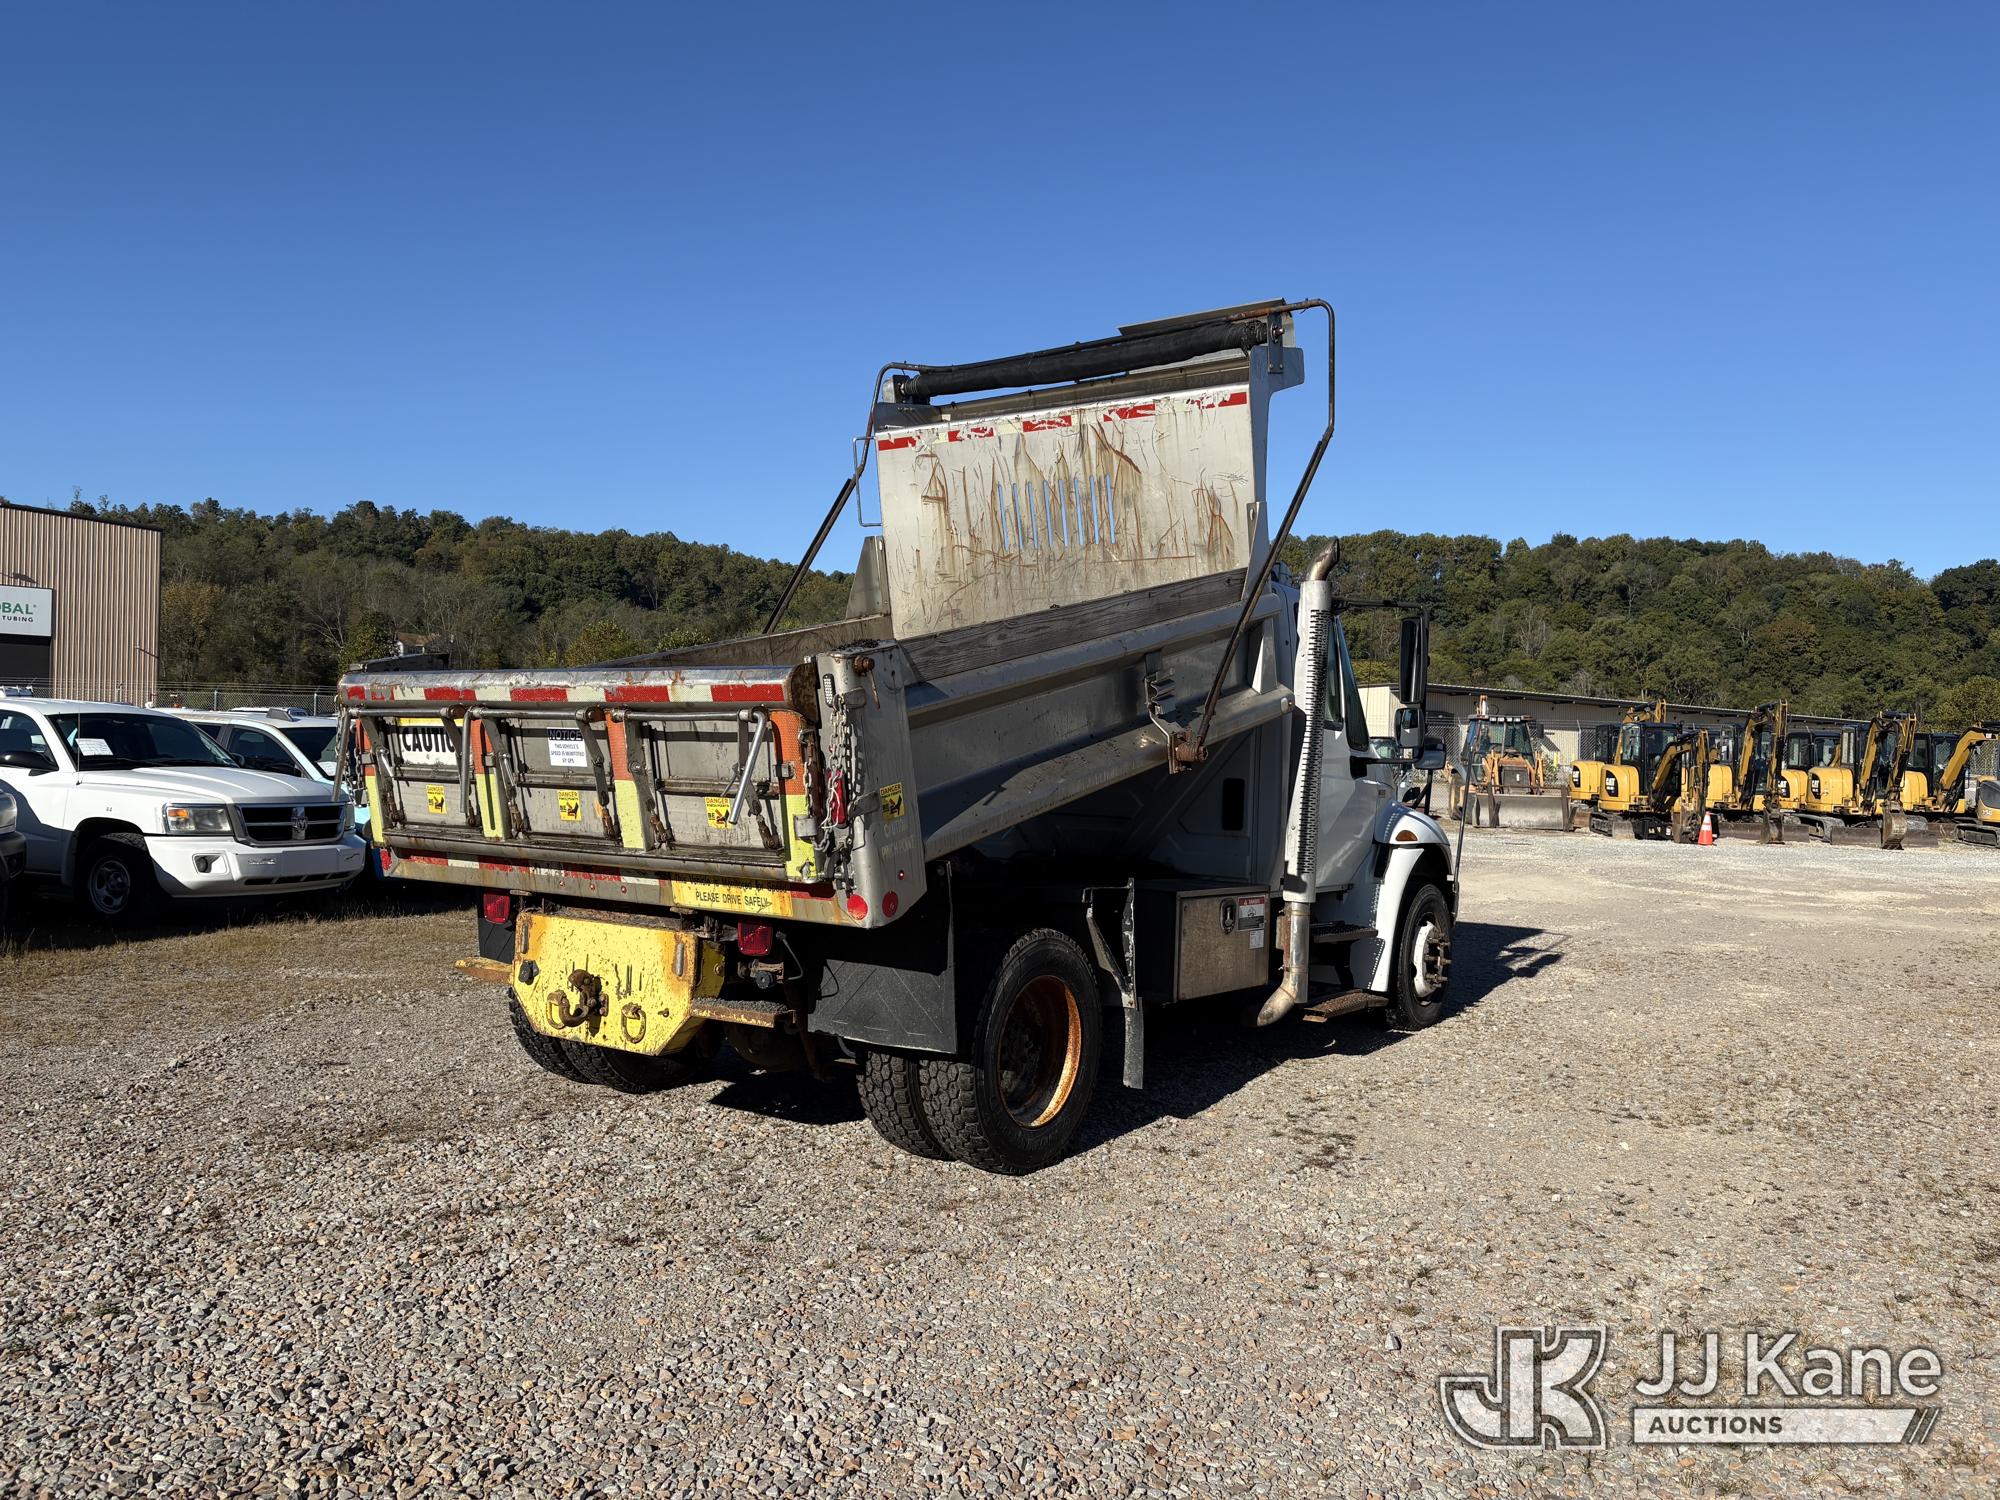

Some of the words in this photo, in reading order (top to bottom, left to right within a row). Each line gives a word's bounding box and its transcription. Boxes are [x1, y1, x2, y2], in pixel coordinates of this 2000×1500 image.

[0, 602, 34, 615] BAL
[549, 730, 583, 740] NOTICE
[880, 784, 901, 795] DANGER
[695, 891, 720, 903] PLEASE
[722, 893, 742, 905] DRIVE
[744, 895, 769, 907] SAFELY
